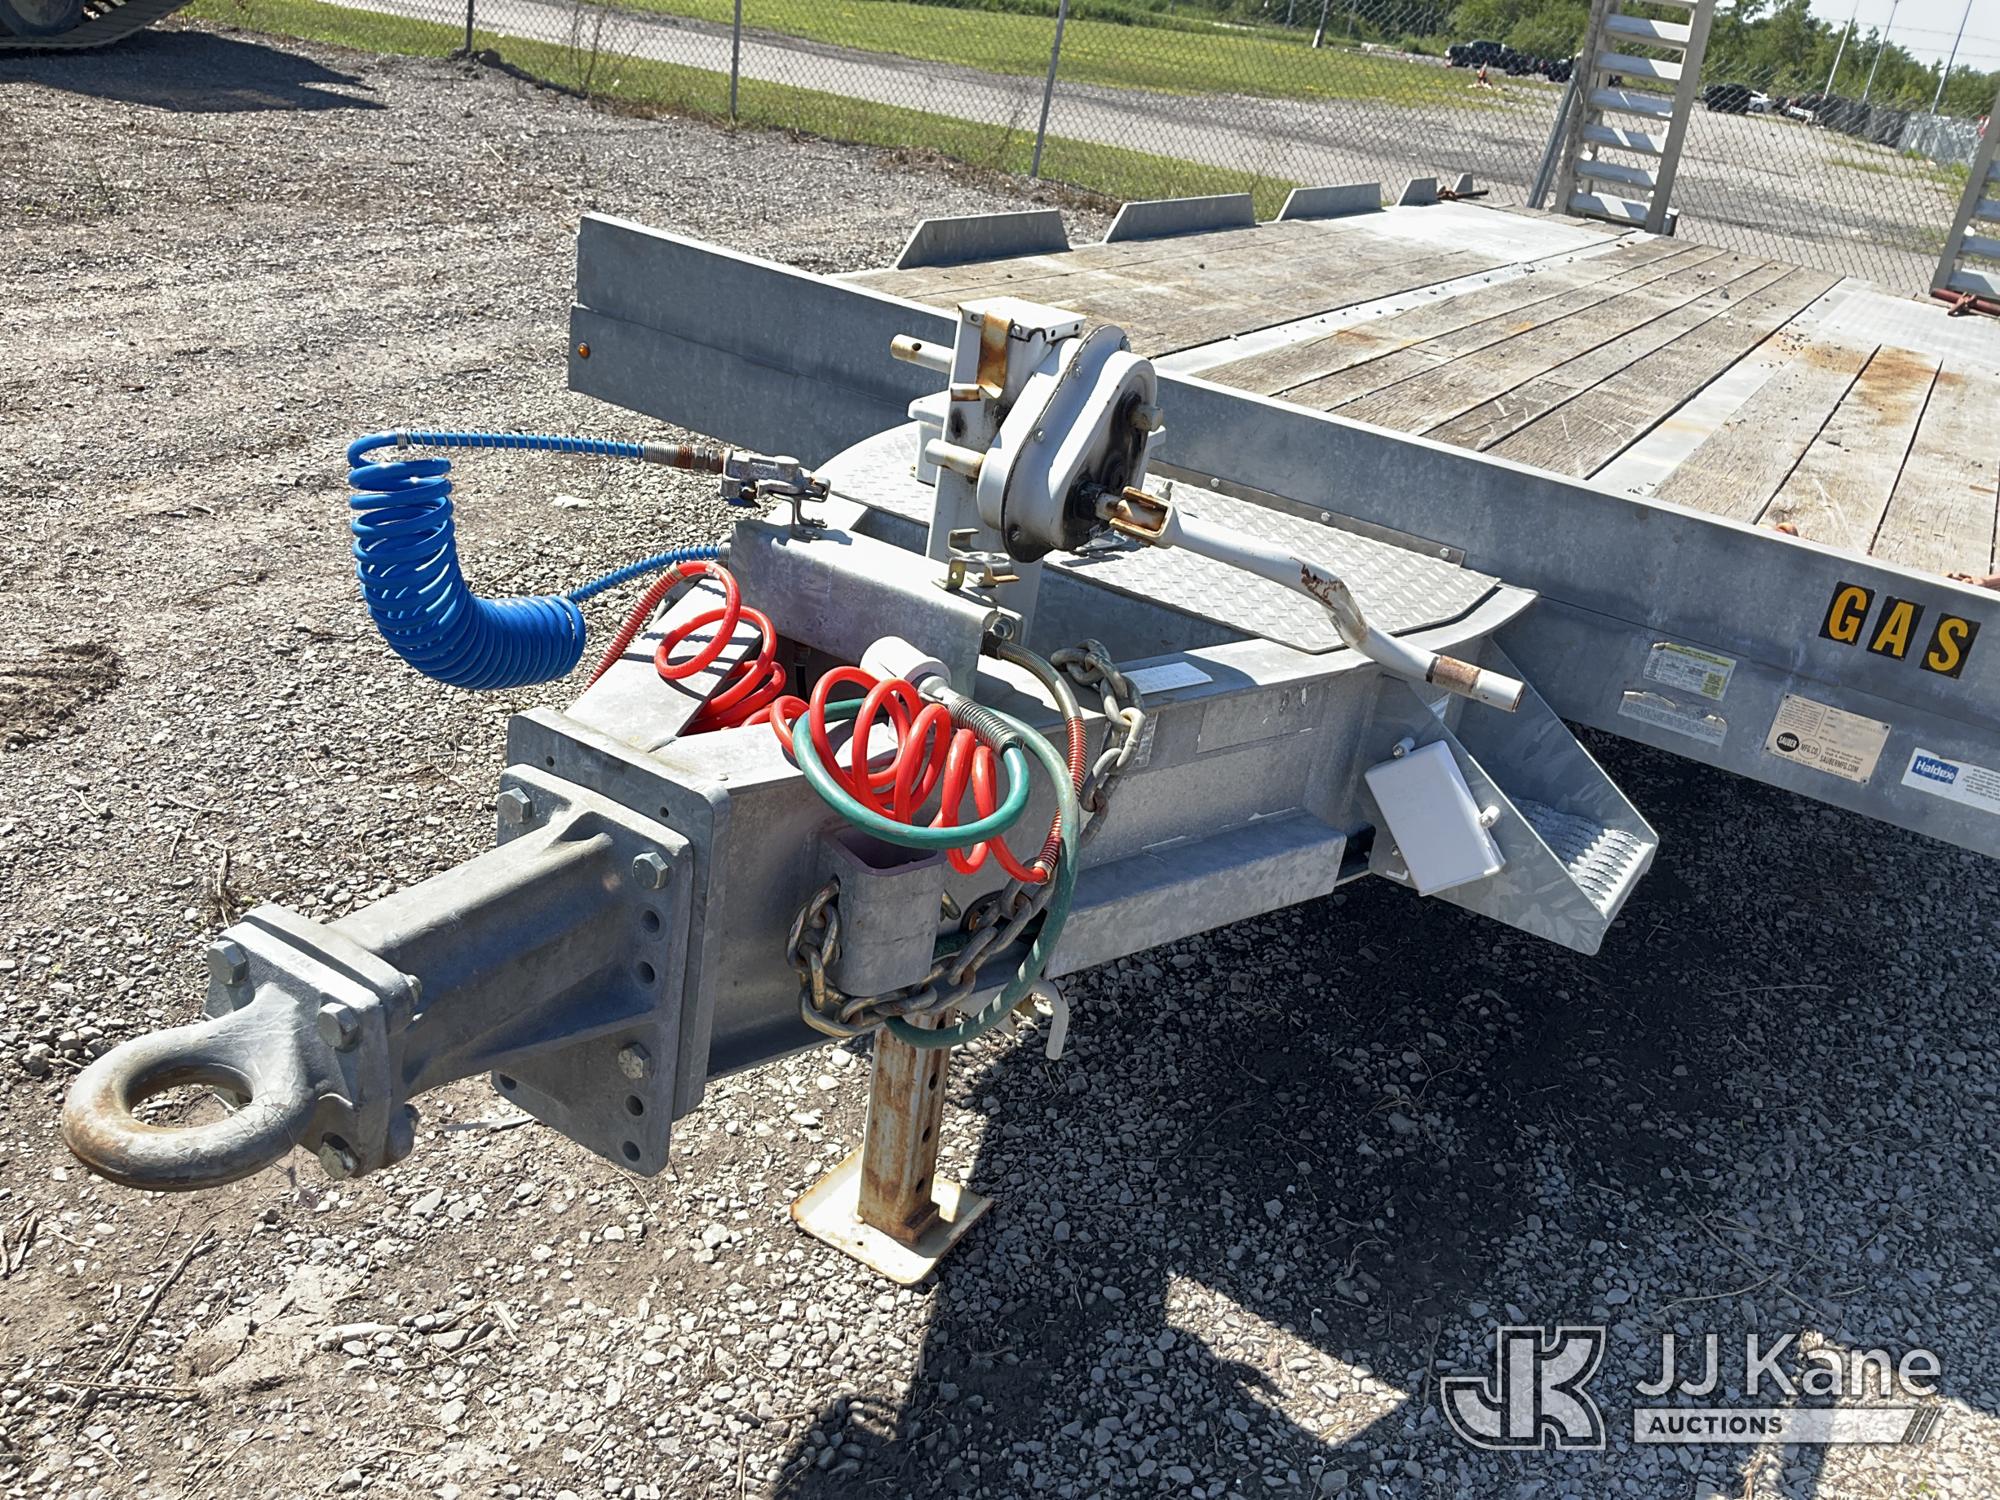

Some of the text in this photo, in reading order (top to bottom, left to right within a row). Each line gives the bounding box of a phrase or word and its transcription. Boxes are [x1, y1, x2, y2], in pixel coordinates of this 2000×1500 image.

[1828, 586, 1969, 672] GAS
[1778, 735, 1798, 749] SAUBER
[1820, 754, 1860, 773] SAUBERMFG.COM
[1916, 760, 1955, 780] Haldex
